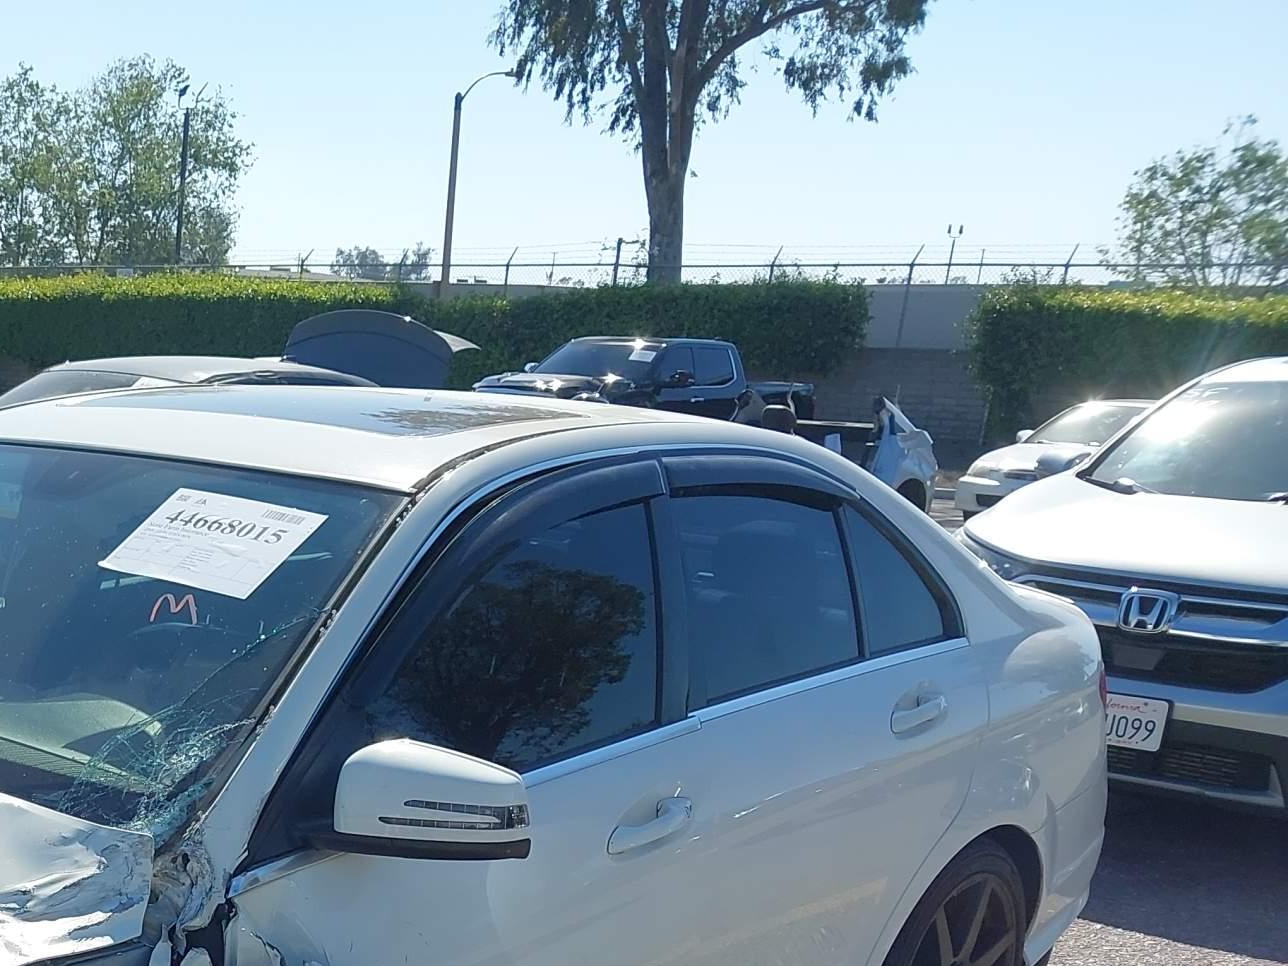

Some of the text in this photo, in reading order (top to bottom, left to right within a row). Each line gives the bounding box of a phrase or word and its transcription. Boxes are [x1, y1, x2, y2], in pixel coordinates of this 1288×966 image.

[165, 508, 289, 545] 44668015
[150, 593, 198, 625] M
[1105, 713, 1157, 742] U099
